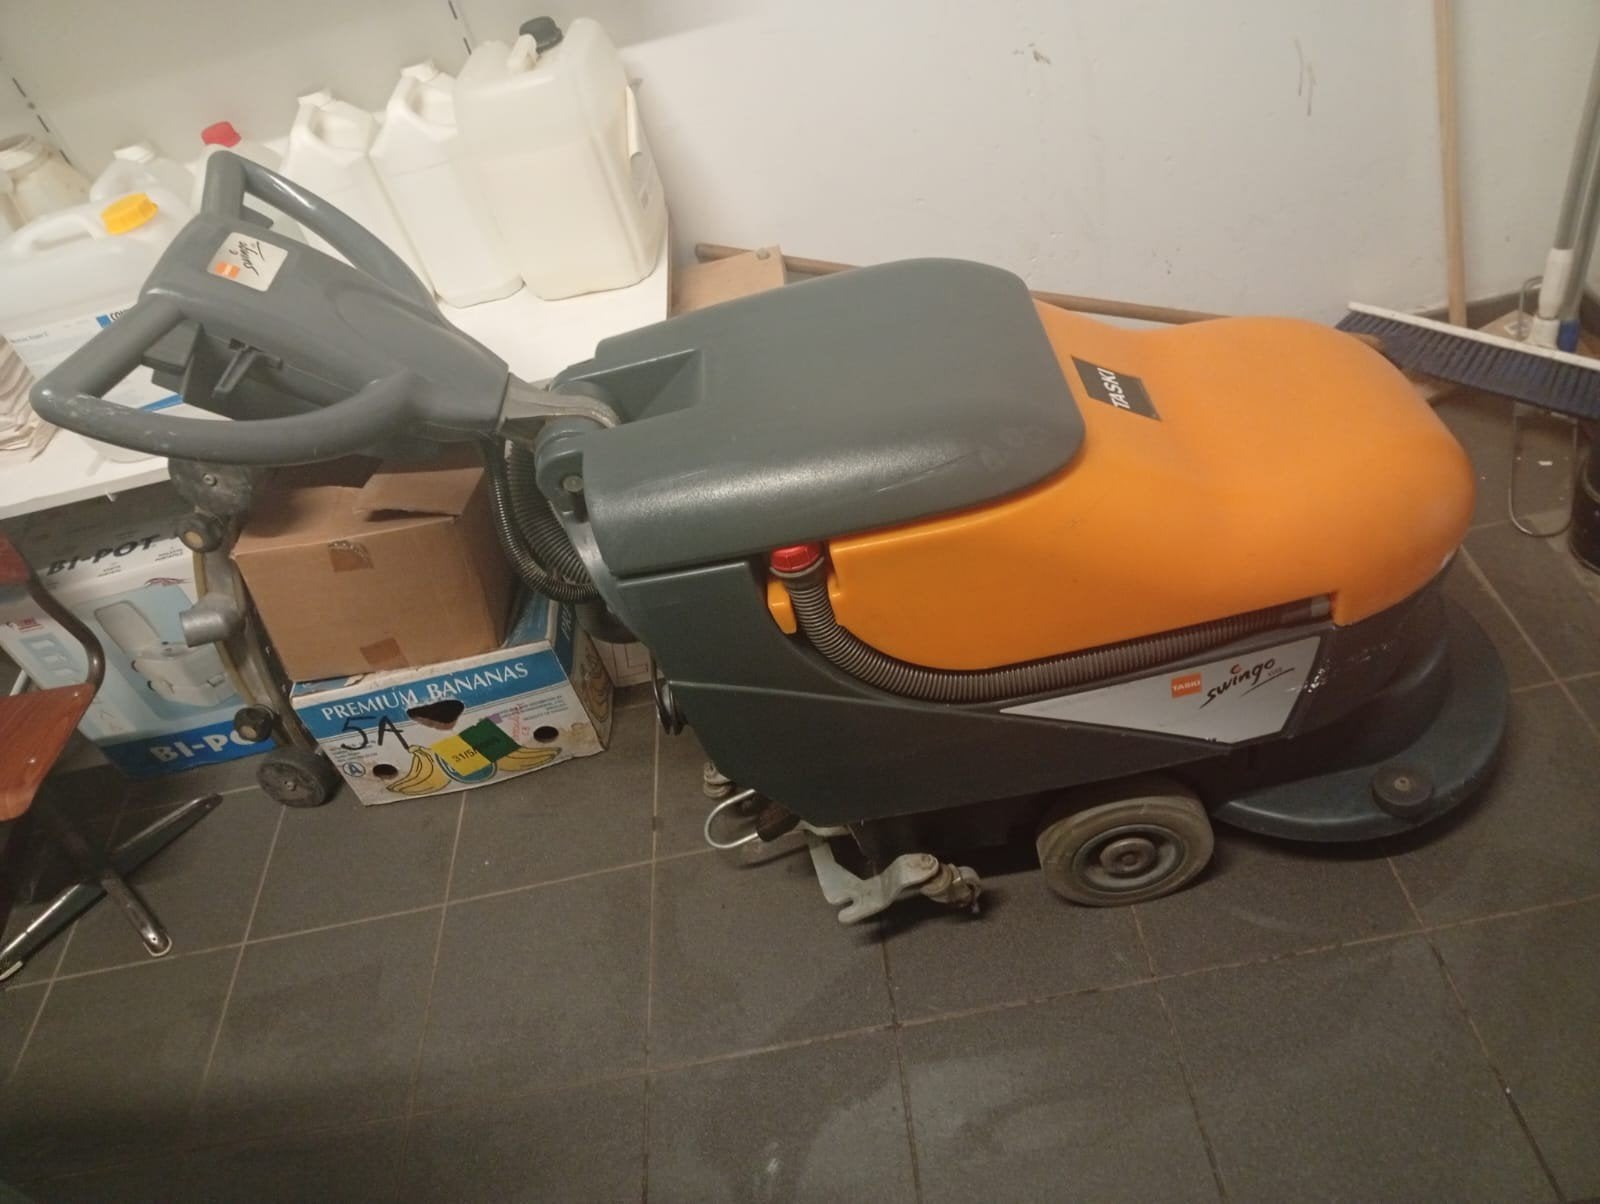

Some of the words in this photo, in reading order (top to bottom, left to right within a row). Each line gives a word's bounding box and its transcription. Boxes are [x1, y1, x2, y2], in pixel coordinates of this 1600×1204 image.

[1097, 367, 1130, 409] TASKI
[321, 688, 418, 721] PREMIUM
[426, 662, 529, 701] BANANAS
[1200, 658, 1276, 709] swingo
[340, 715, 409, 753] 5A
